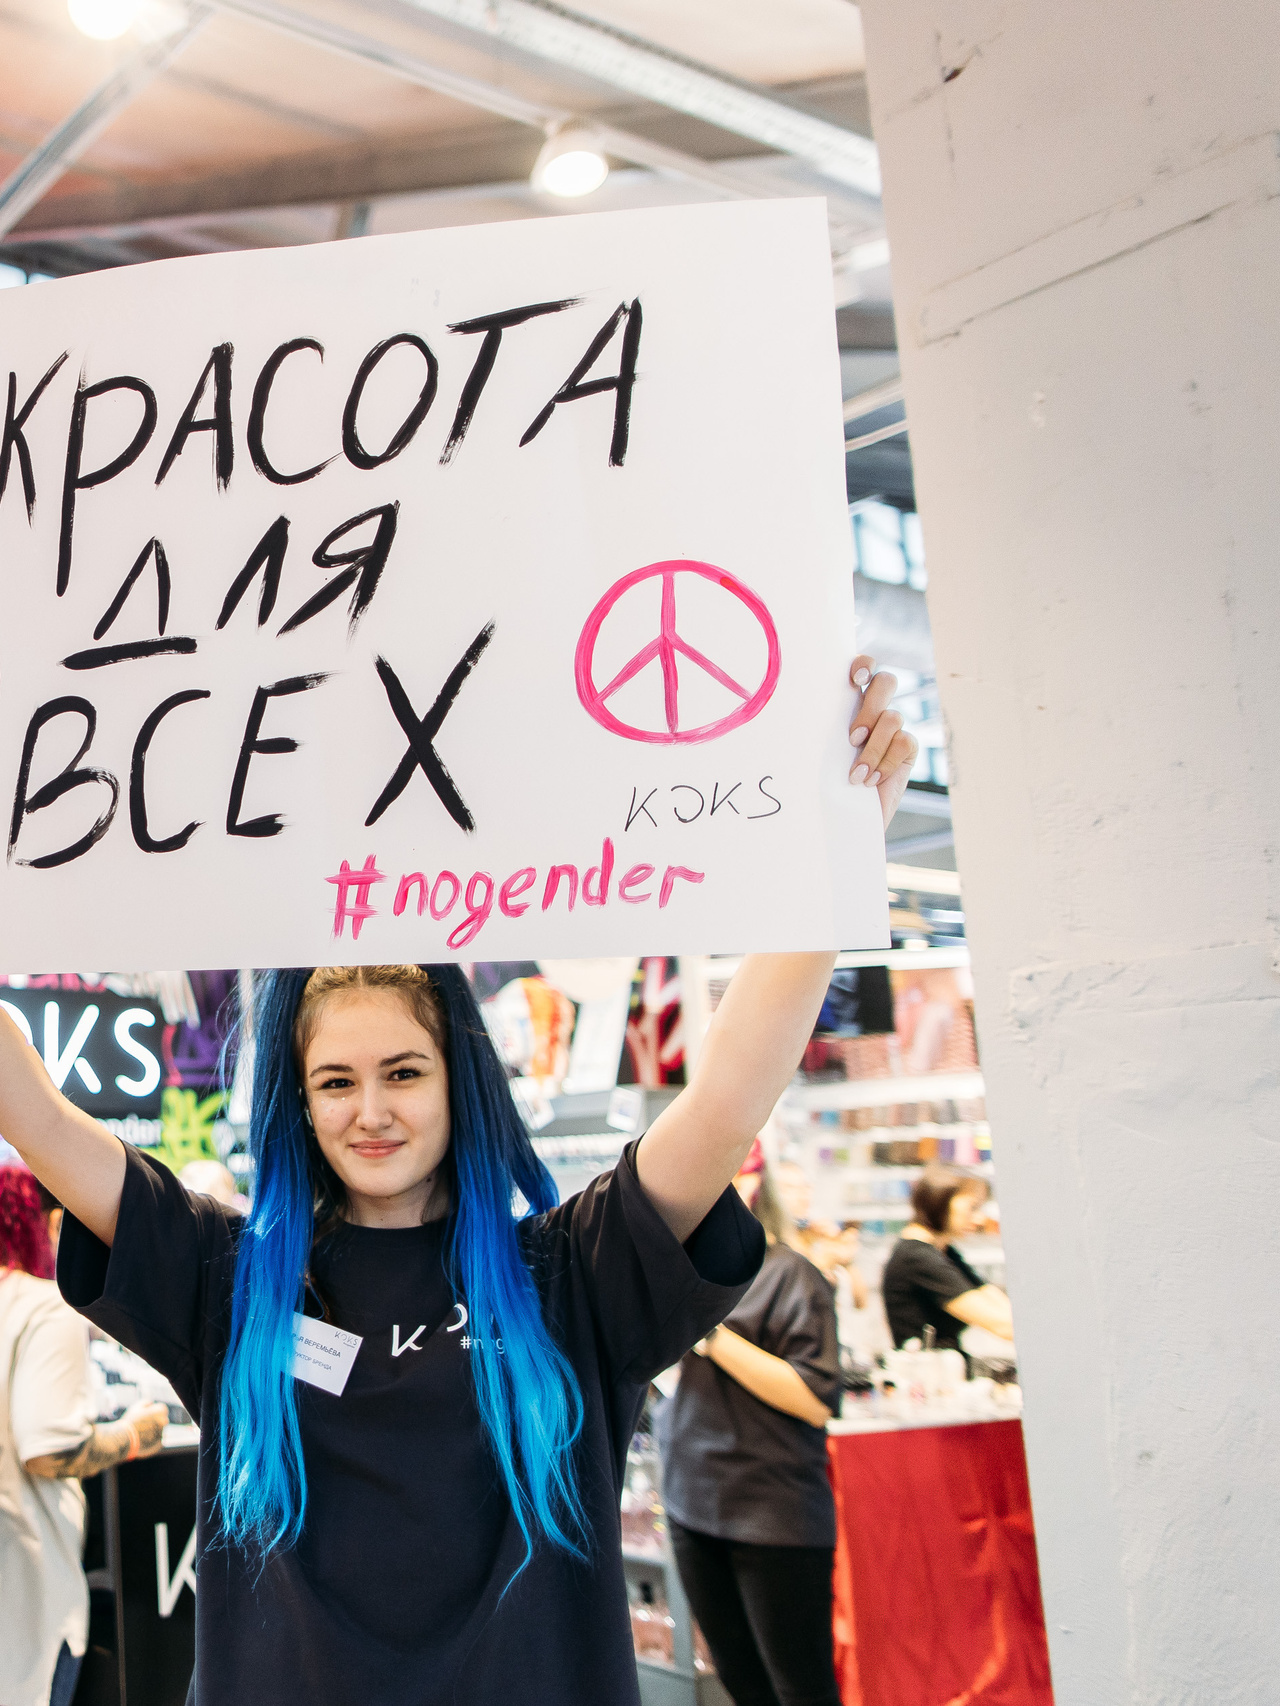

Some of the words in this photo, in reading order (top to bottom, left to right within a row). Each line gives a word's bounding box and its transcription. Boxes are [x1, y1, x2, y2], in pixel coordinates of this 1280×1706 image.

[60, 500, 400, 671] ДЛЯ
[6, 621, 495, 869] ВСЕХ
[324, 836, 705, 950] #nogender
